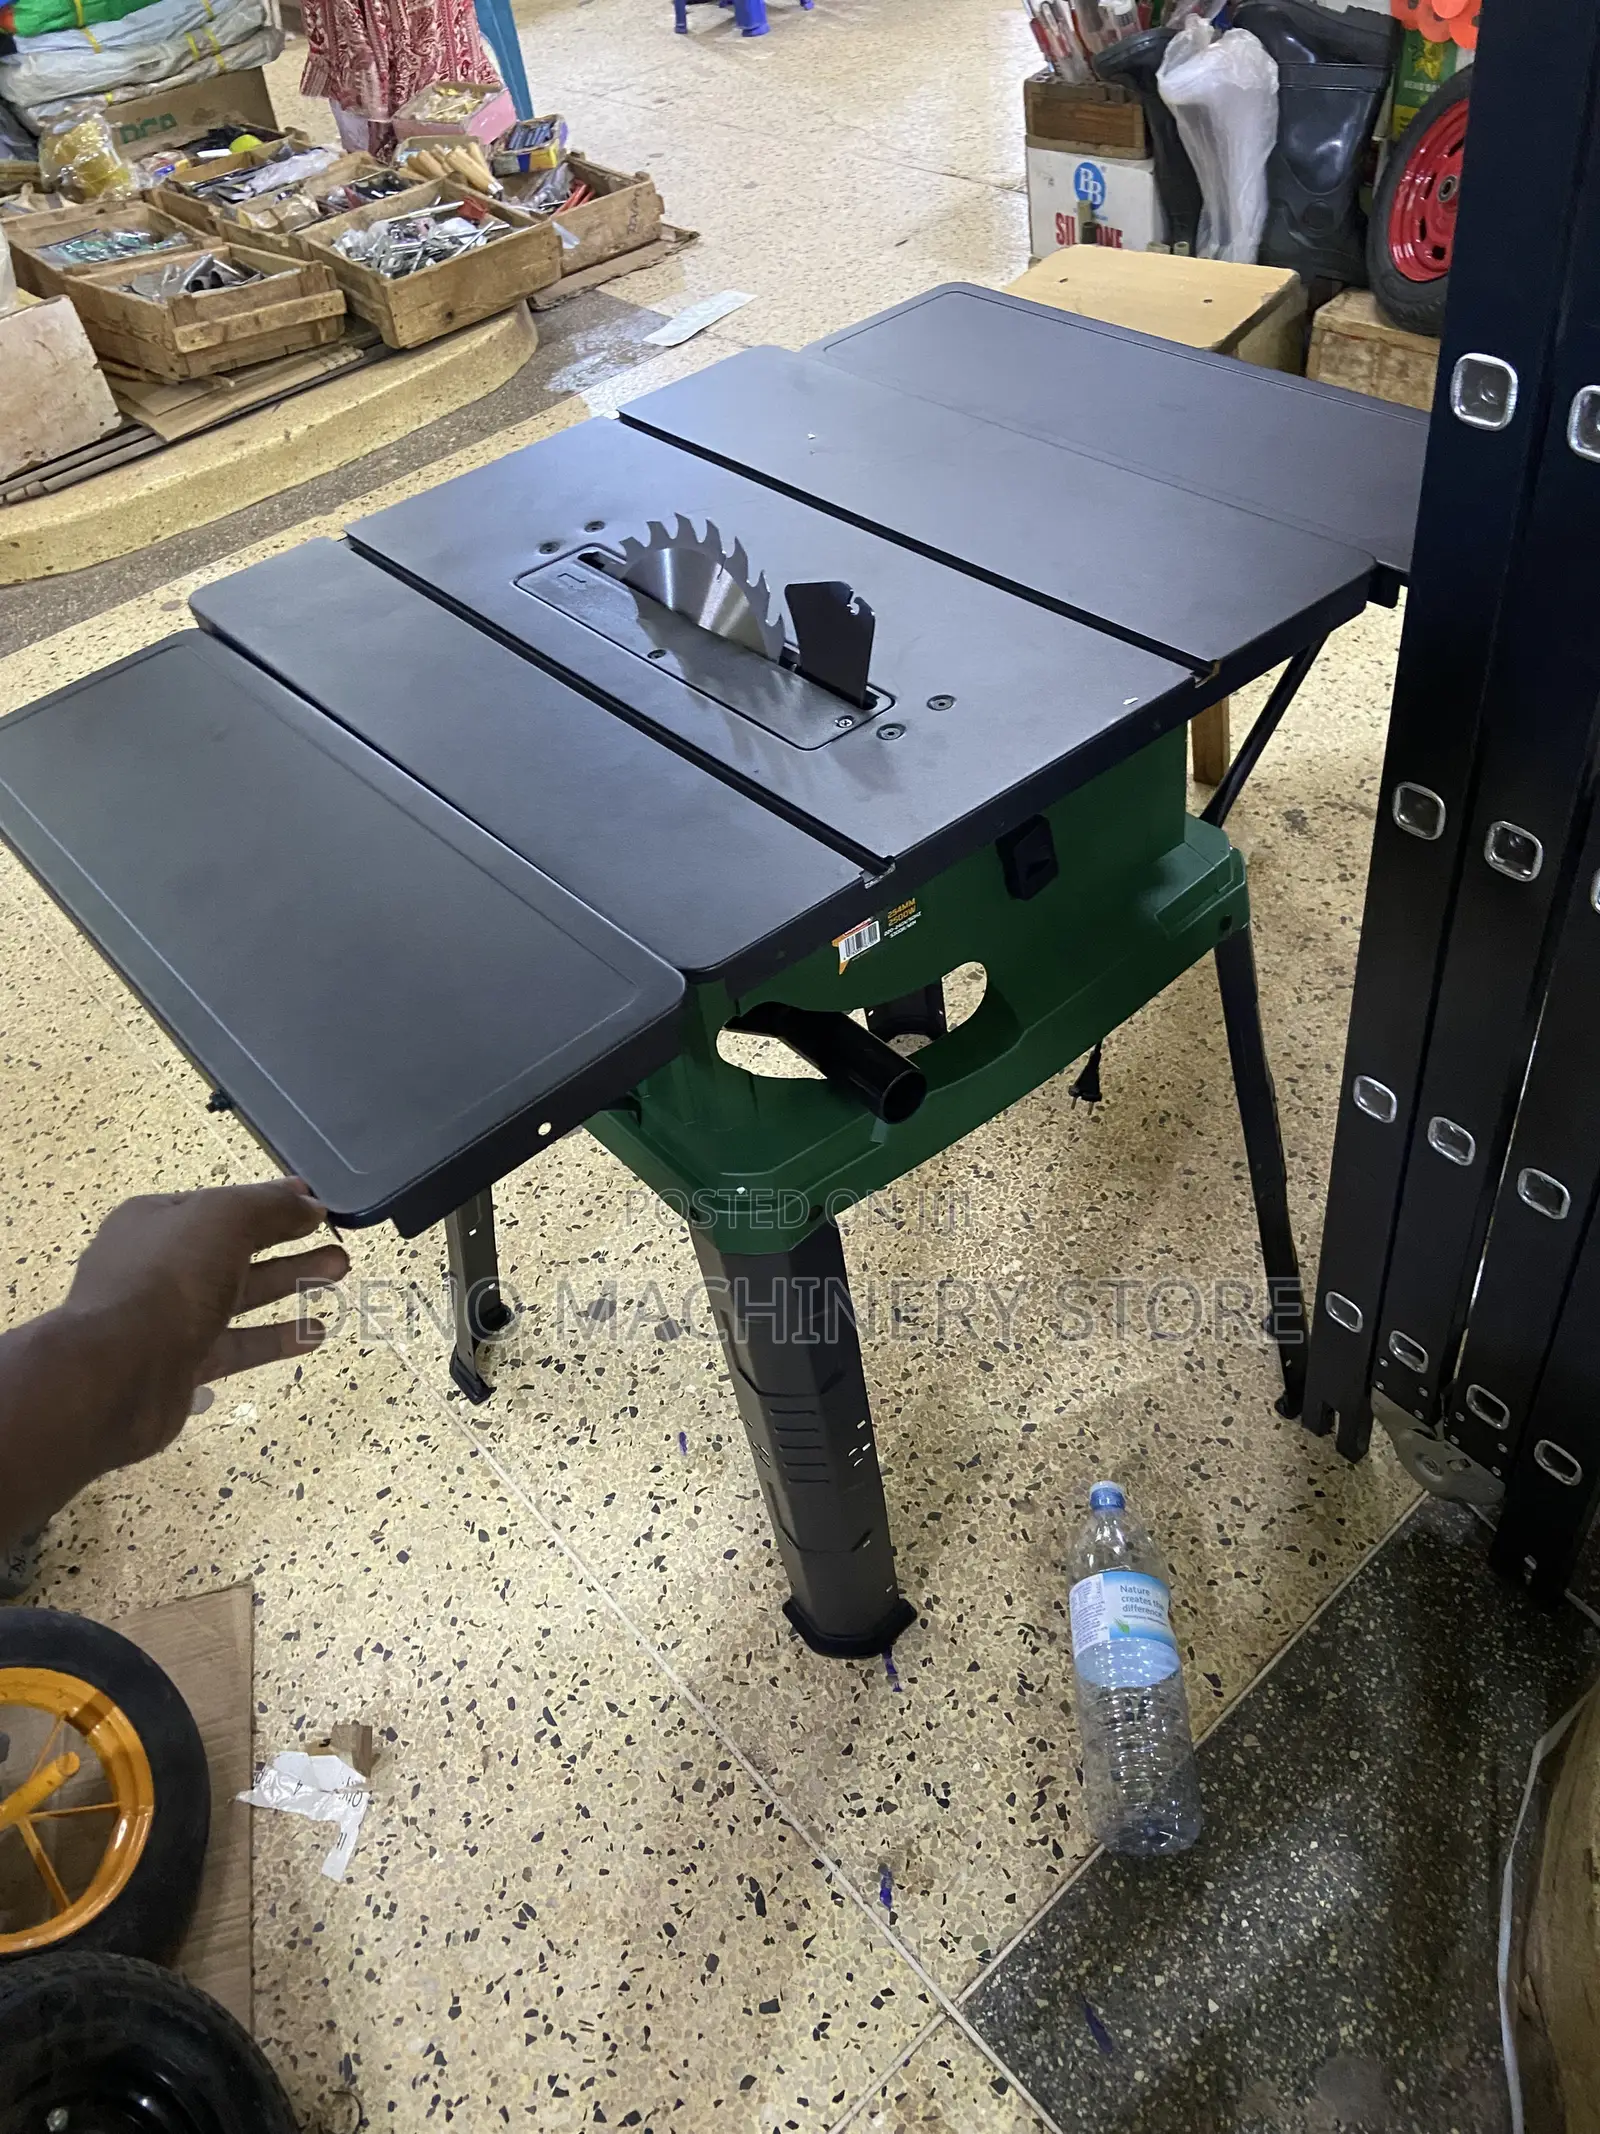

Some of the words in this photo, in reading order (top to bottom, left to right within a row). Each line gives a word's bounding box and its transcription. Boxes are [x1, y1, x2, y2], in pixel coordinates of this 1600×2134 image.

[1056, 212, 1123, 248] SILONE
[1119, 1584, 1151, 1596] Nature
[1121, 1595, 1153, 1606] creates
